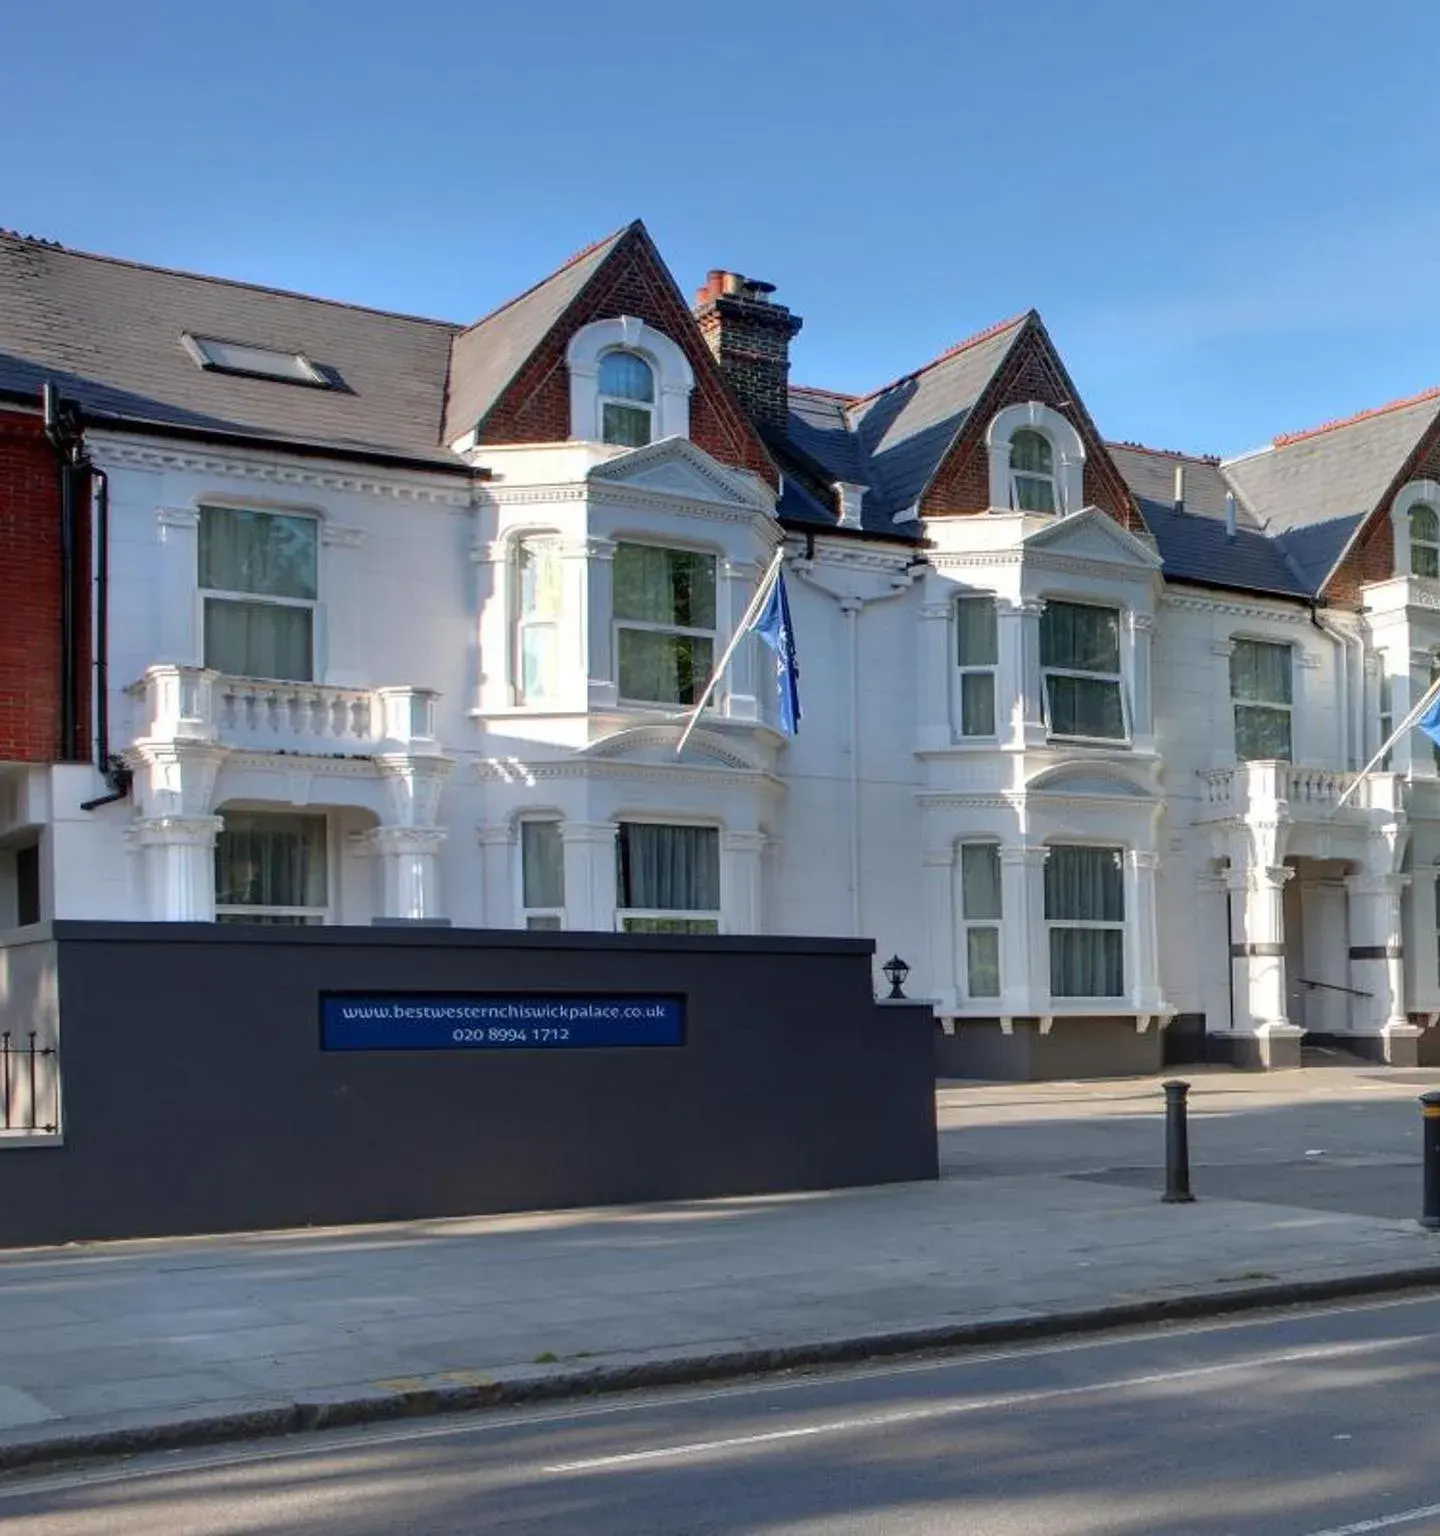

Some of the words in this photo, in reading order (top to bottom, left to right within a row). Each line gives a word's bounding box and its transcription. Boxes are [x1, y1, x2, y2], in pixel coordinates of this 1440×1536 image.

[342, 1003, 666, 1019] www.bestwesternchiswickpalace.co.uk
[452, 1028, 484, 1041] 020
[488, 1028, 527, 1041] 8994
[533, 1027, 570, 1040] 1712
